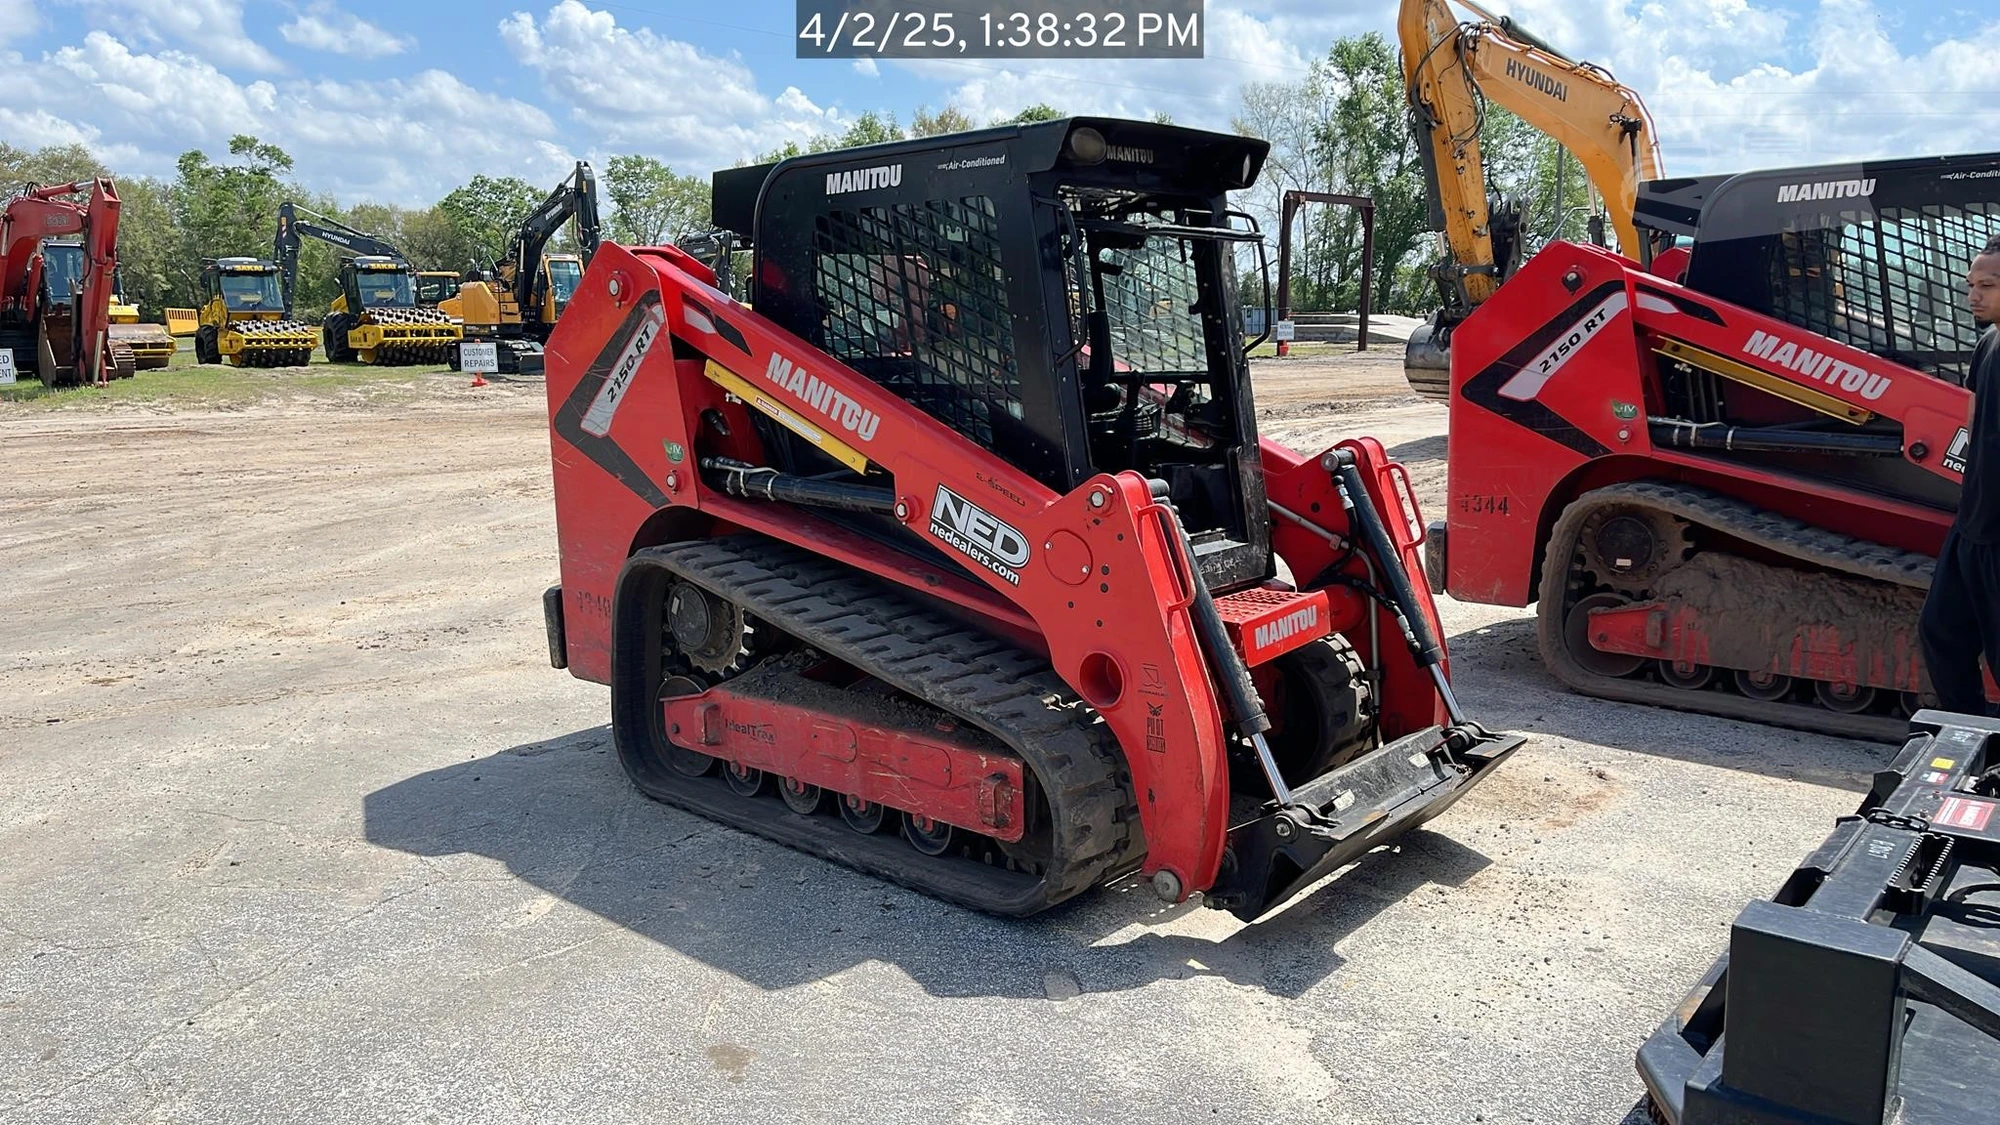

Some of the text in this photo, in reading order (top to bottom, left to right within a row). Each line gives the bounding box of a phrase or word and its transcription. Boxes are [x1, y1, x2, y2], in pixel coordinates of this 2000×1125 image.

[1506, 57, 1568, 102] HYUNDAI
[948, 154, 1006, 170] Air-Conditioned
[1106, 145, 1154, 164] MANITOU
[826, 164, 902, 195] MANITOU
[1777, 178, 1877, 203] MANITOU
[322, 231, 350, 245] HYUNDAI
[1539, 307, 1606, 374] 2150 RT
[464, 359, 495, 368] REPAIRS
[607, 324, 651, 403] 2150 RT
[1742, 329, 1892, 400] MANITOU
[765, 351, 881, 442] MANITOU
[932, 486, 1029, 565] NED
[929, 522, 1020, 586] nedealers.com
[1254, 604, 1317, 650] MANITOU
